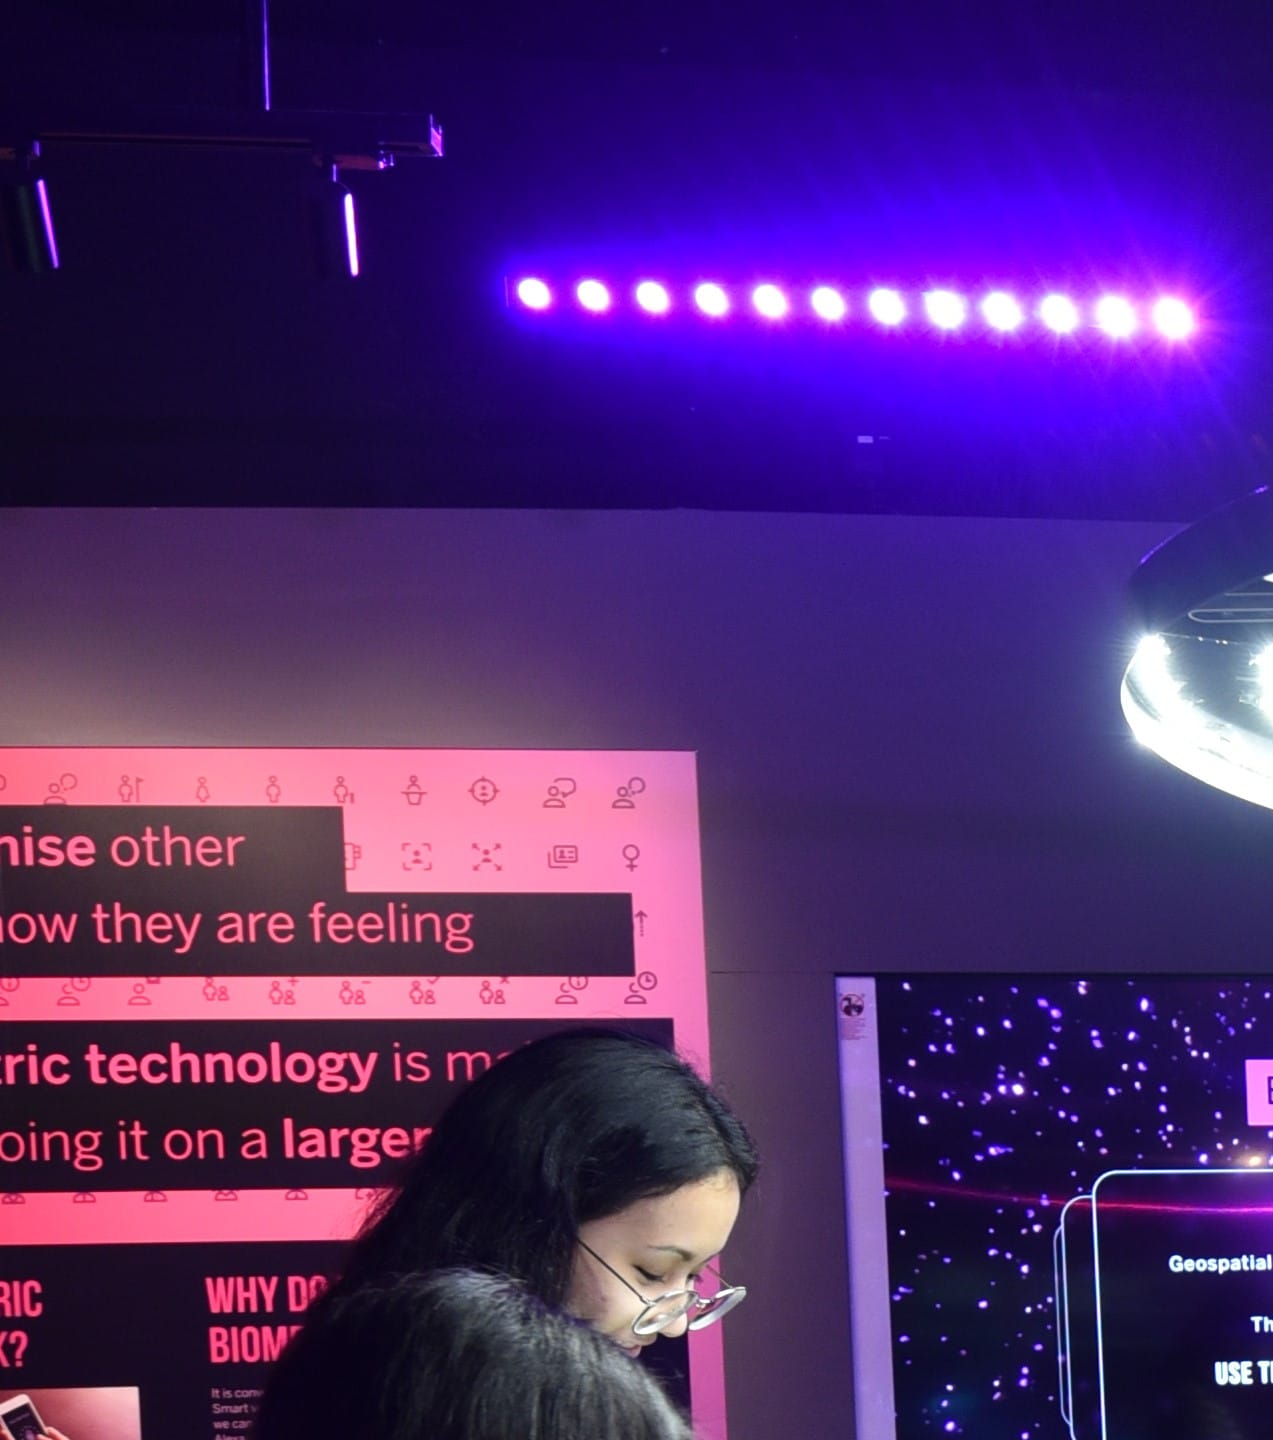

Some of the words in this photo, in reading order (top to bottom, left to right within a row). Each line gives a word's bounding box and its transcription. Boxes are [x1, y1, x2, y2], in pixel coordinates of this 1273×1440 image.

[110, 825, 246, 867] other
[0, 912, 78, 944] ow
[91, 901, 202, 954] they
[216, 912, 295, 944] are
[309, 902, 475, 953] feeling
[0, 1043, 71, 1085] ric
[84, 1041, 379, 1093] technology
[392, 1041, 431, 1082] is
[447, 1051, 511, 1082] m
[118, 1119, 150, 1160] it
[163, 1128, 225, 1160] on
[240, 1128, 268, 1159] a
[1168, 1254, 1272, 1274] Geospatial
[205, 1276, 279, 1314] WHY
[209, 1325, 304, 1364] BIOM
[1214, 1361, 1253, 1386] USE
[212, 1403, 249, 1414] Smart
[222, 1388, 233, 1399] is
